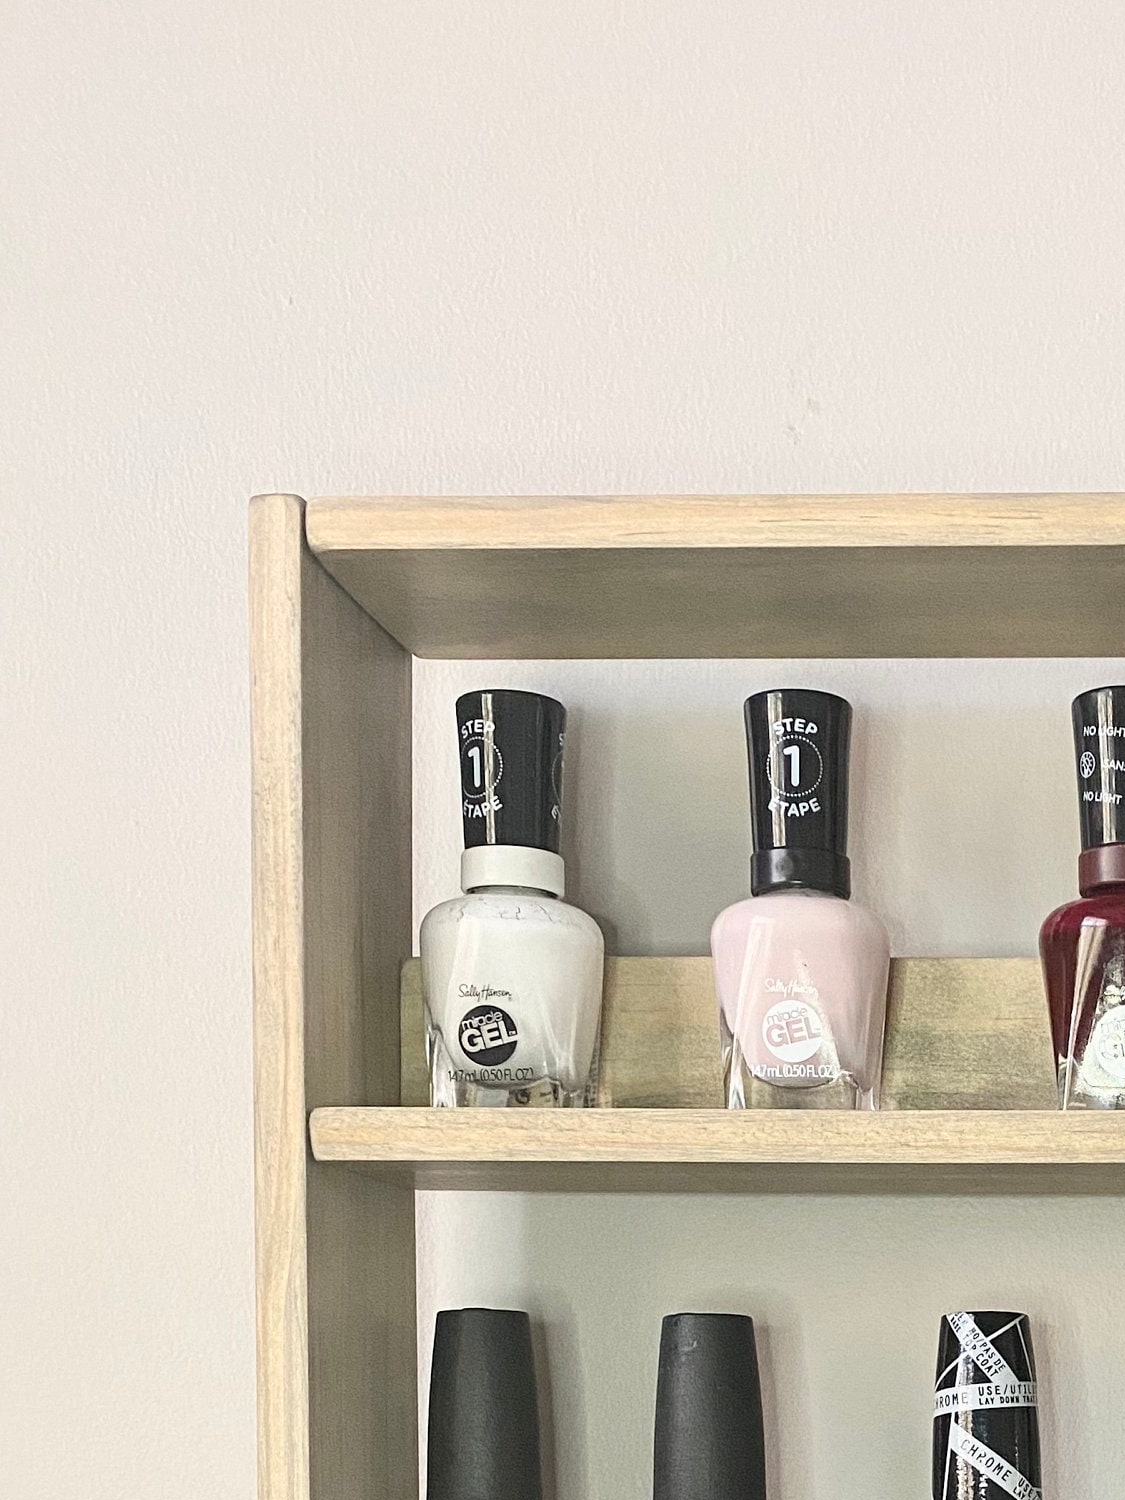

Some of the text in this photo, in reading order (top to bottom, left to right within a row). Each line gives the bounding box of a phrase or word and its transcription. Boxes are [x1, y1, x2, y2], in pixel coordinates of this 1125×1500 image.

[461, 719, 496, 739] STEP
[772, 718, 818, 735] STEP
[1083, 726, 1097, 736] NO
[467, 746, 481, 788] 1
[783, 745, 800, 787] 1
[1083, 791, 1094, 802] NO
[458, 983, 480, 1001] Sally
[461, 1020, 518, 1053] GEL
[765, 1016, 822, 1048] GEL
[975, 1352, 999, 1377] COAT
[961, 1439, 1012, 1482] CHROME
